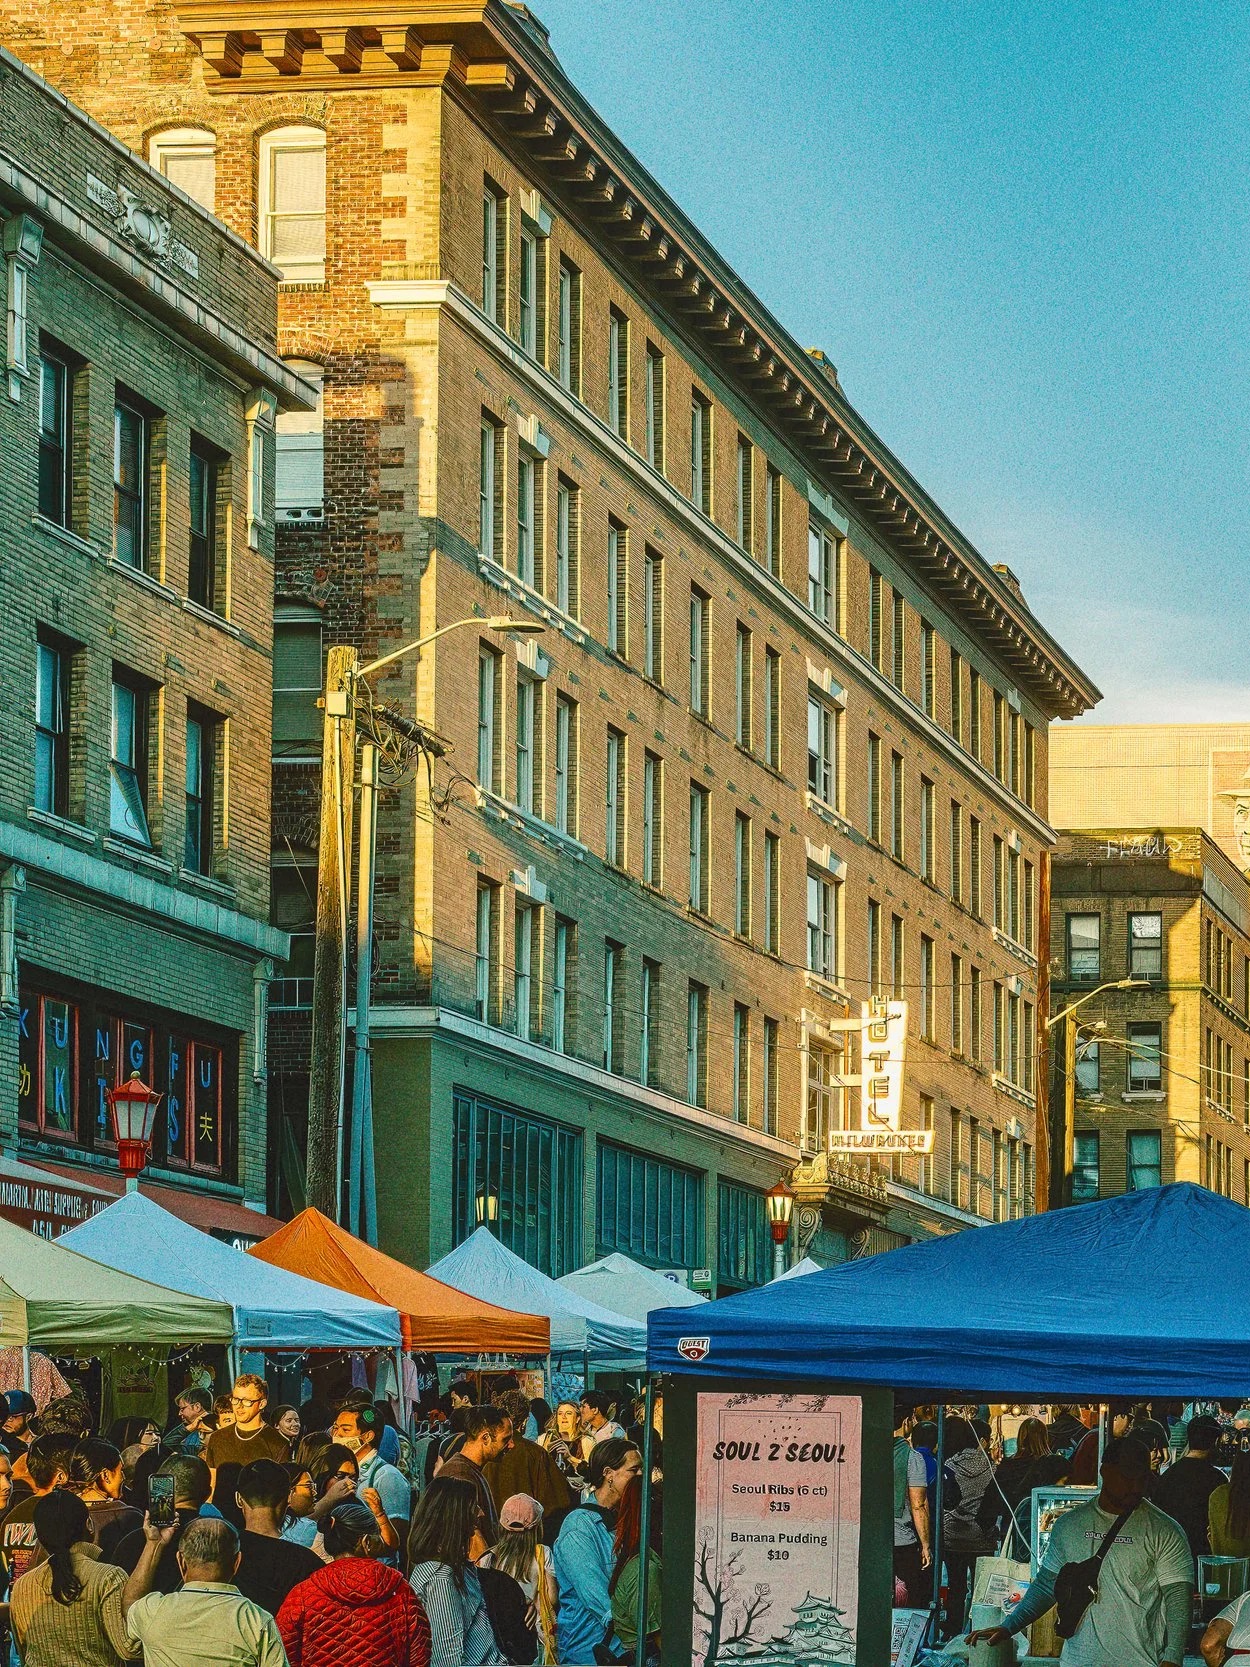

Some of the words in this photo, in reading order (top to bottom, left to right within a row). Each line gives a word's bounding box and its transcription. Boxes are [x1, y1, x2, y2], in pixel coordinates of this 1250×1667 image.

[868, 994, 891, 1125] HOTEL
[713, 1440, 760, 1460] SOUL
[768, 1443, 780, 1461] 2
[785, 1443, 847, 1463] SEOUL
[732, 1484, 766, 1494] Seoul
[768, 1484, 794, 1495] Ribs
[797, 1485, 809, 1496] (6
[812, 1485, 828, 1497] ct)
[731, 1532, 776, 1543] Banana
[778, 1533, 828, 1546] Pudding
[767, 1549, 790, 1561] $10
